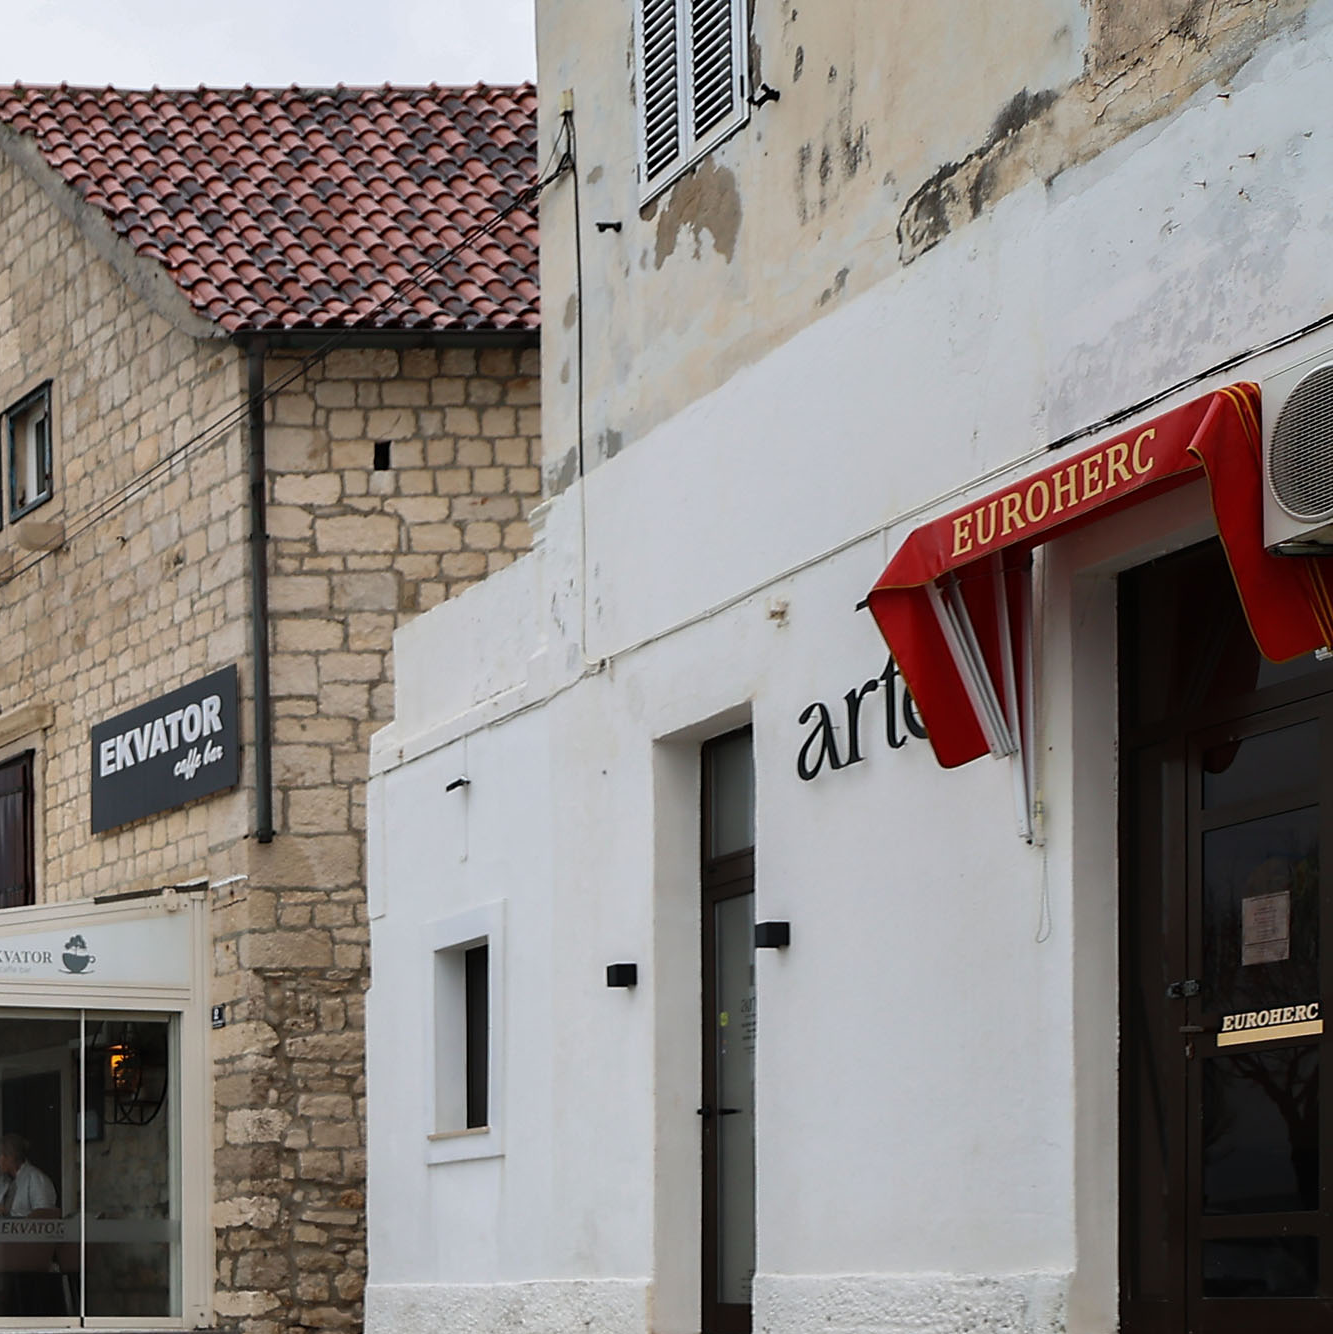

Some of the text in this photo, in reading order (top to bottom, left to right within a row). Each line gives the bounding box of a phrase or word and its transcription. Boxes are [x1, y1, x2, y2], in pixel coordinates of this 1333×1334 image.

[951, 428, 1156, 558] EUROHERC
[100, 694, 223, 778] EKVATOR
[174, 739, 224, 780] caffe bar
[1222, 1003, 1320, 1032] EUROHERC
[0, 1221, 66, 1235] EKVATOR
